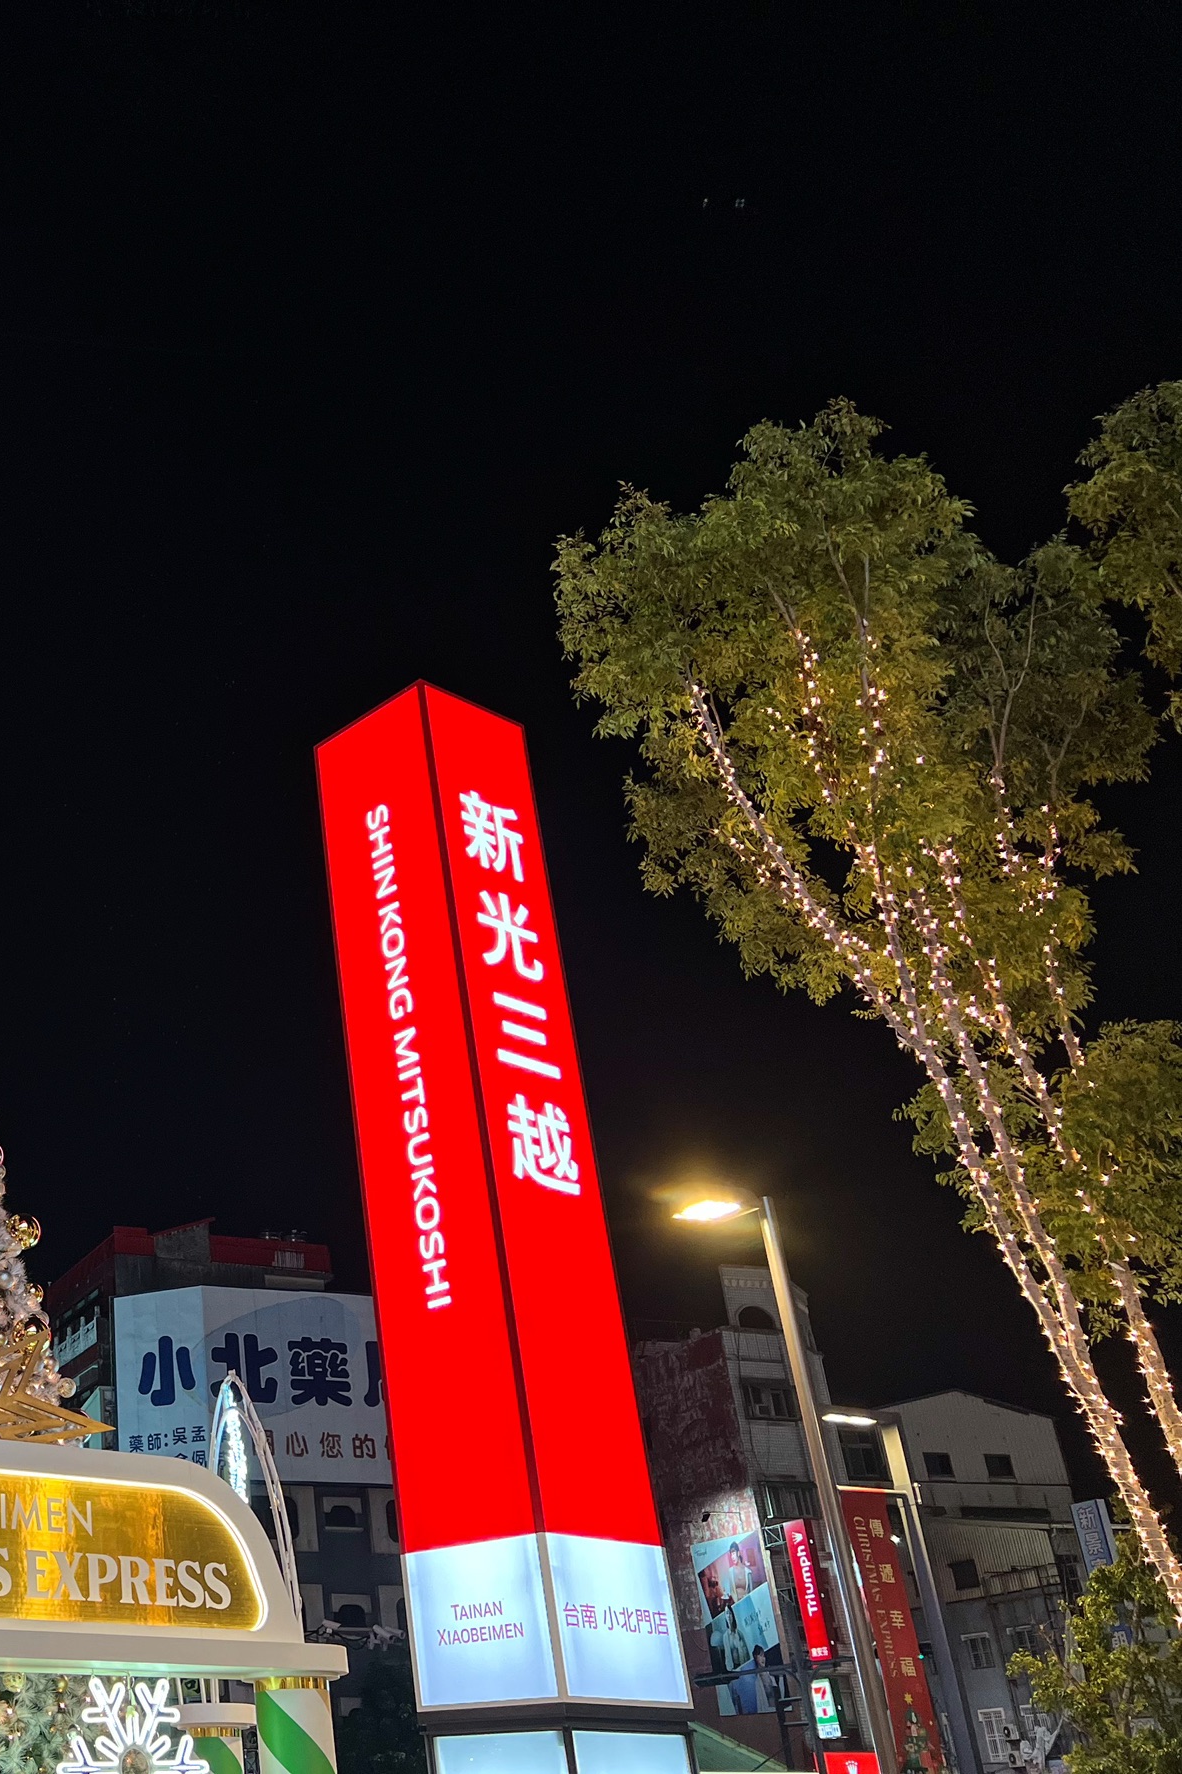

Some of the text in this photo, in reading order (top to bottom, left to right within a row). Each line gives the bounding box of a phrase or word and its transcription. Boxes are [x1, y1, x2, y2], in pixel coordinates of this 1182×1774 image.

[459, 790, 581, 1197] 新光三越
[366, 803, 452, 1310] SHIN KONG MITSUKOSHI
[26, 1549, 232, 1610] EXPRESS
[450, 1600, 503, 1622] TAINAN
[794, 1544, 819, 1618] Triumph
[852, 1515, 899, 1679] CHRISTMAS EXPRESS
[436, 1621, 525, 1647] XIAOBEIMEN
[562, 1601, 669, 1636] 台南 小北門店
